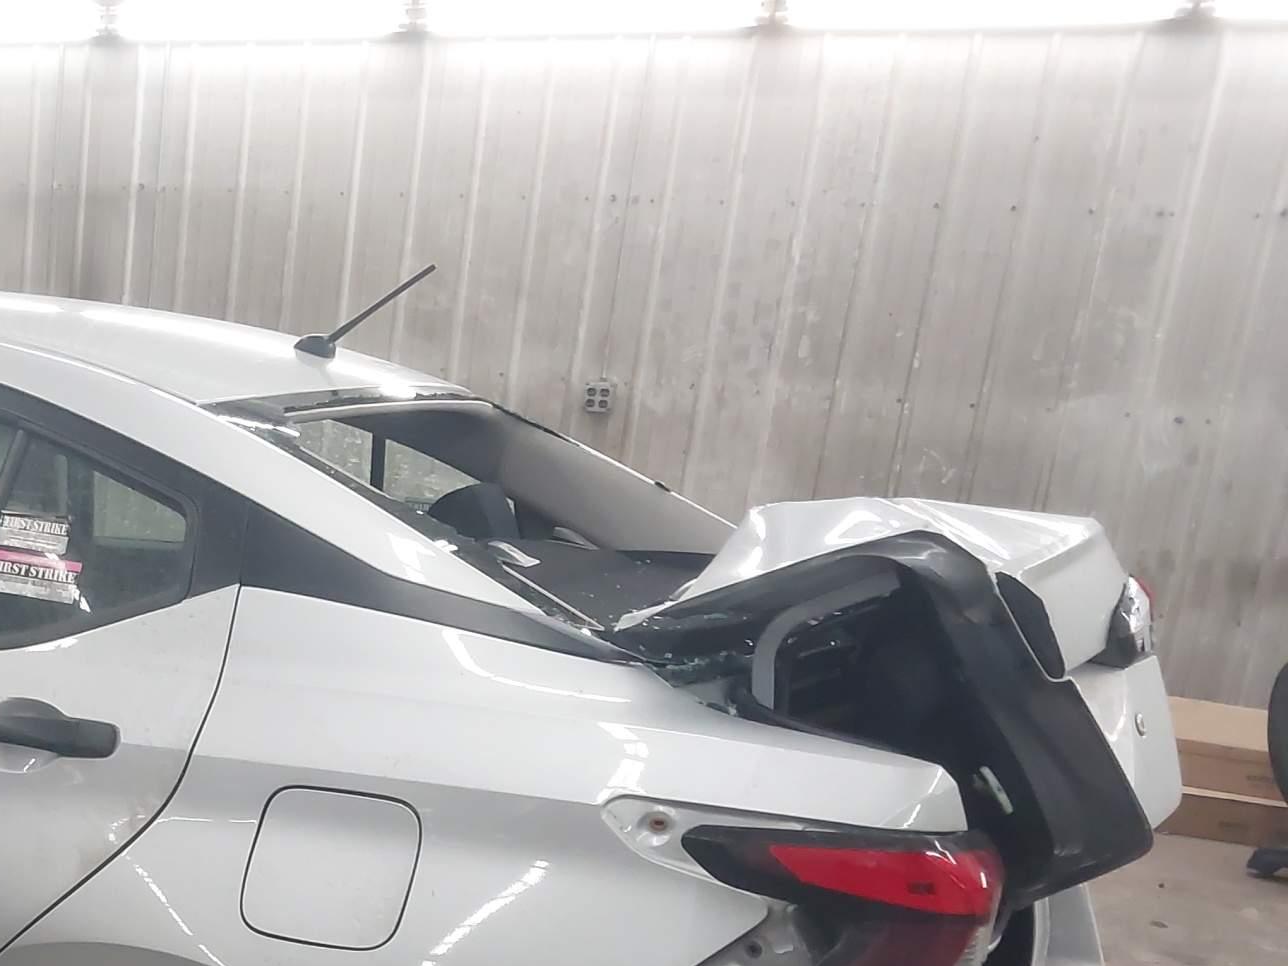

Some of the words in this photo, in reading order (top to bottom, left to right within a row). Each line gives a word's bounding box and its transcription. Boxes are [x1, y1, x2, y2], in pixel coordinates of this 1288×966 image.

[1, 515, 32, 531] FIRST
[31, 519, 70, 536] STRIKE
[28, 566, 78, 584] STRIKE
